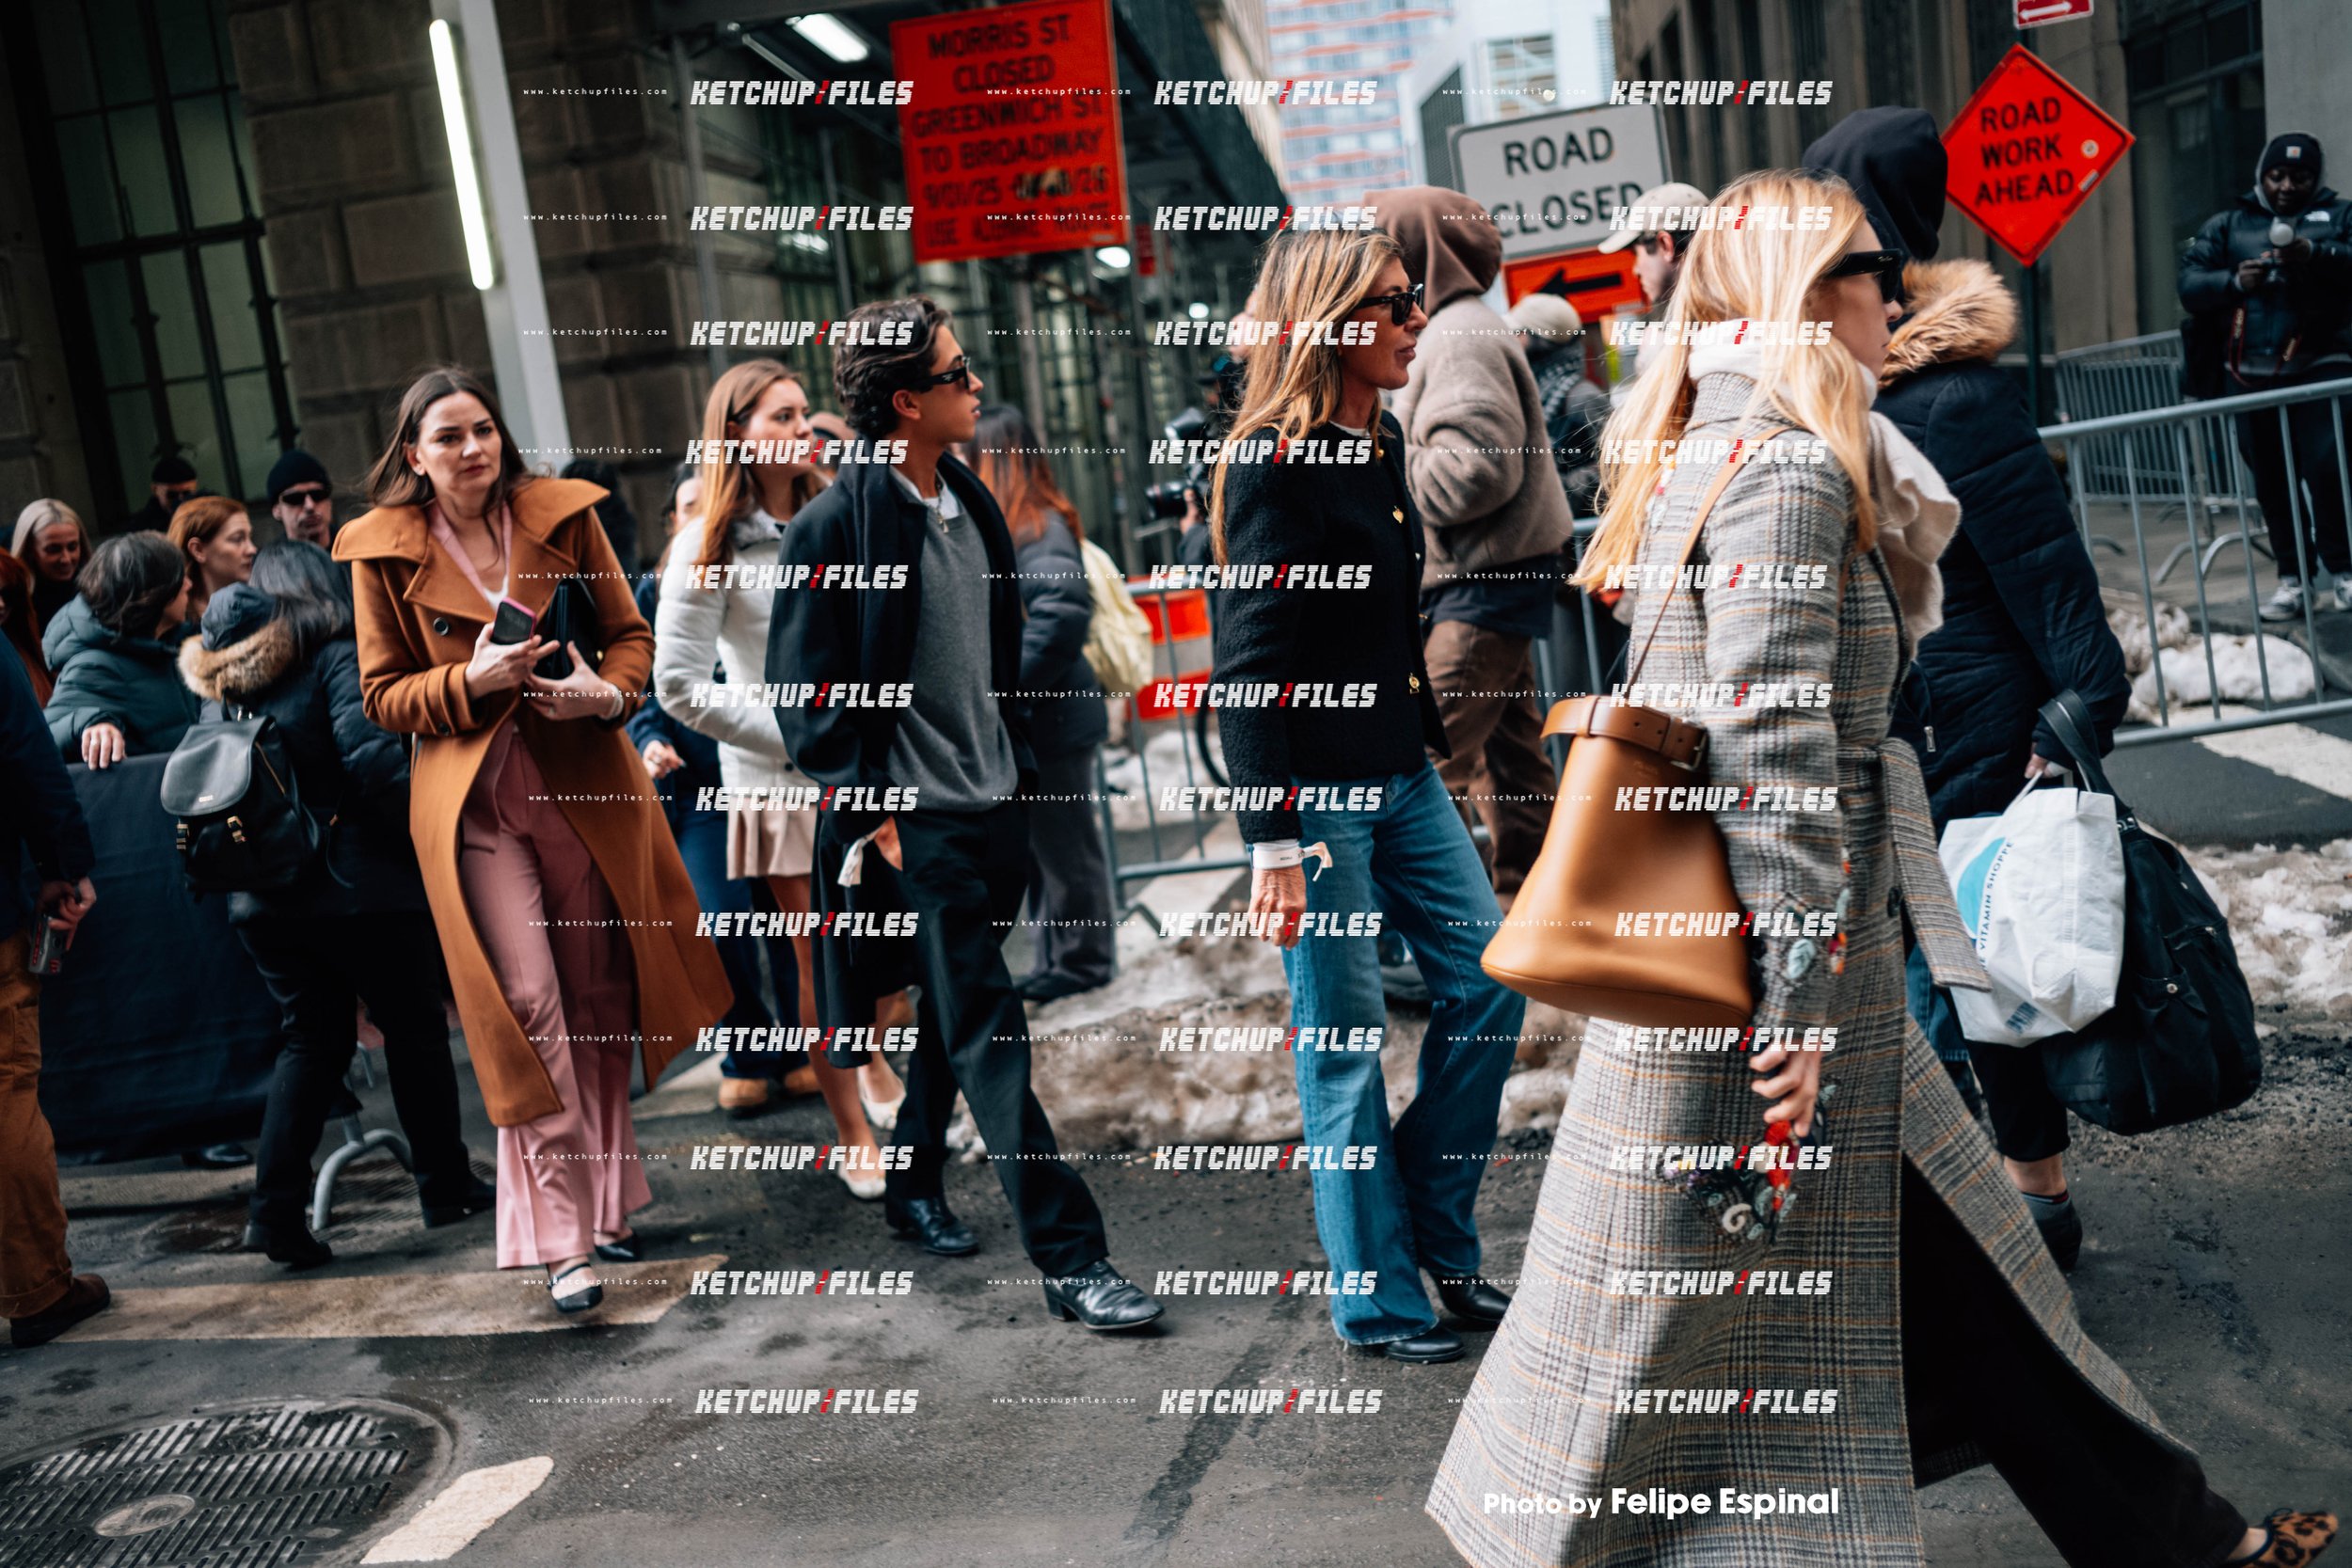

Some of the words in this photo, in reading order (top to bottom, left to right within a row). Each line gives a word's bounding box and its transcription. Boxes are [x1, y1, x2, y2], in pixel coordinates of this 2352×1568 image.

[928, 21, 1029, 59] MORRIS
[1039, 13, 1071, 45] ST
[953, 54, 1056, 93] CLOSED
[912, 95, 1063, 138] GREENWICH
[1979, 96, 2061, 133] ROAD
[918, 145, 953, 174] TO
[959, 127, 1103, 170] BROADWAY
[1503, 126, 1613, 178] ROAD
[1979, 133, 2062, 170] WORK
[1976, 168, 2074, 207] AHEAD
[1979, 895, 1992, 950] VITAMIN
[1987, 842, 2013, 890] SHOPPE
